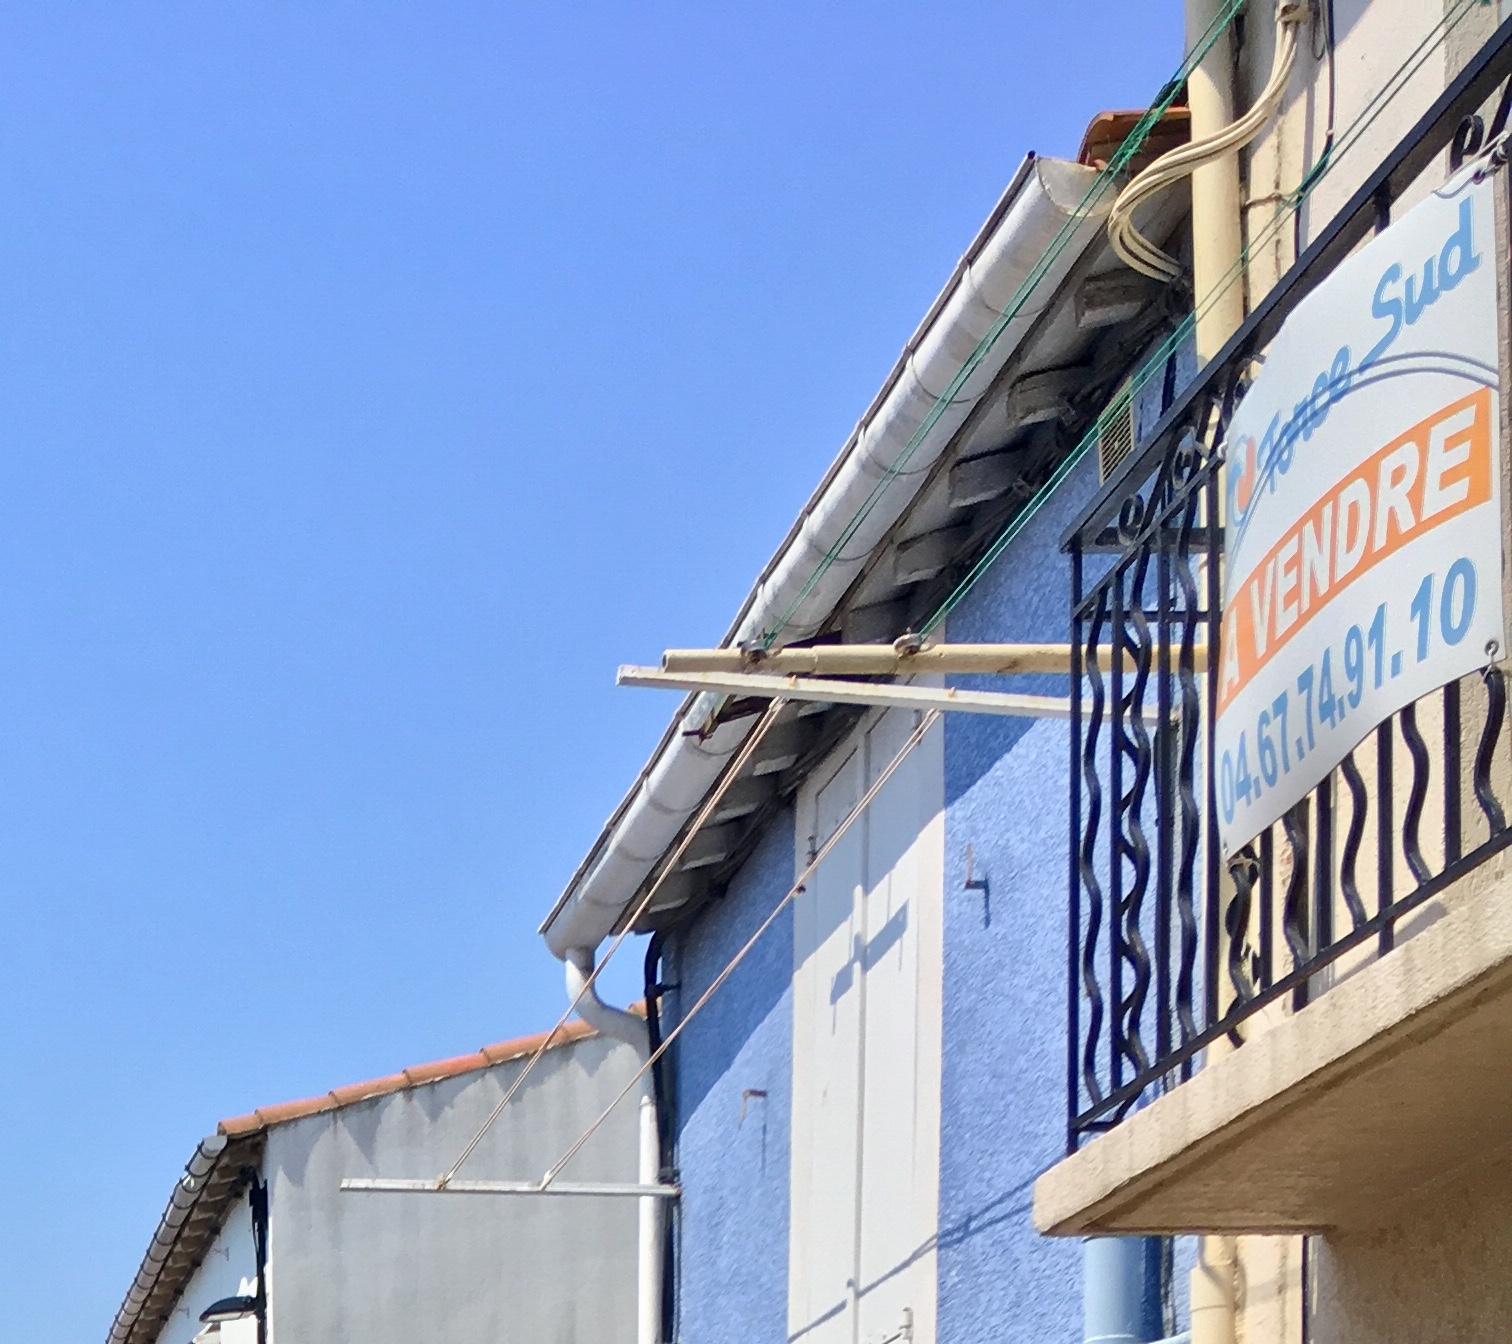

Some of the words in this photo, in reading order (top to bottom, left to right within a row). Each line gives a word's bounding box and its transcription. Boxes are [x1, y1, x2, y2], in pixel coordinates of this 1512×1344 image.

[1358, 195, 1482, 378] Sud
[1220, 605, 1241, 703] A
[1249, 402, 1478, 660] VENDRE
[1219, 555, 1479, 826] 04.67.74.91.10
